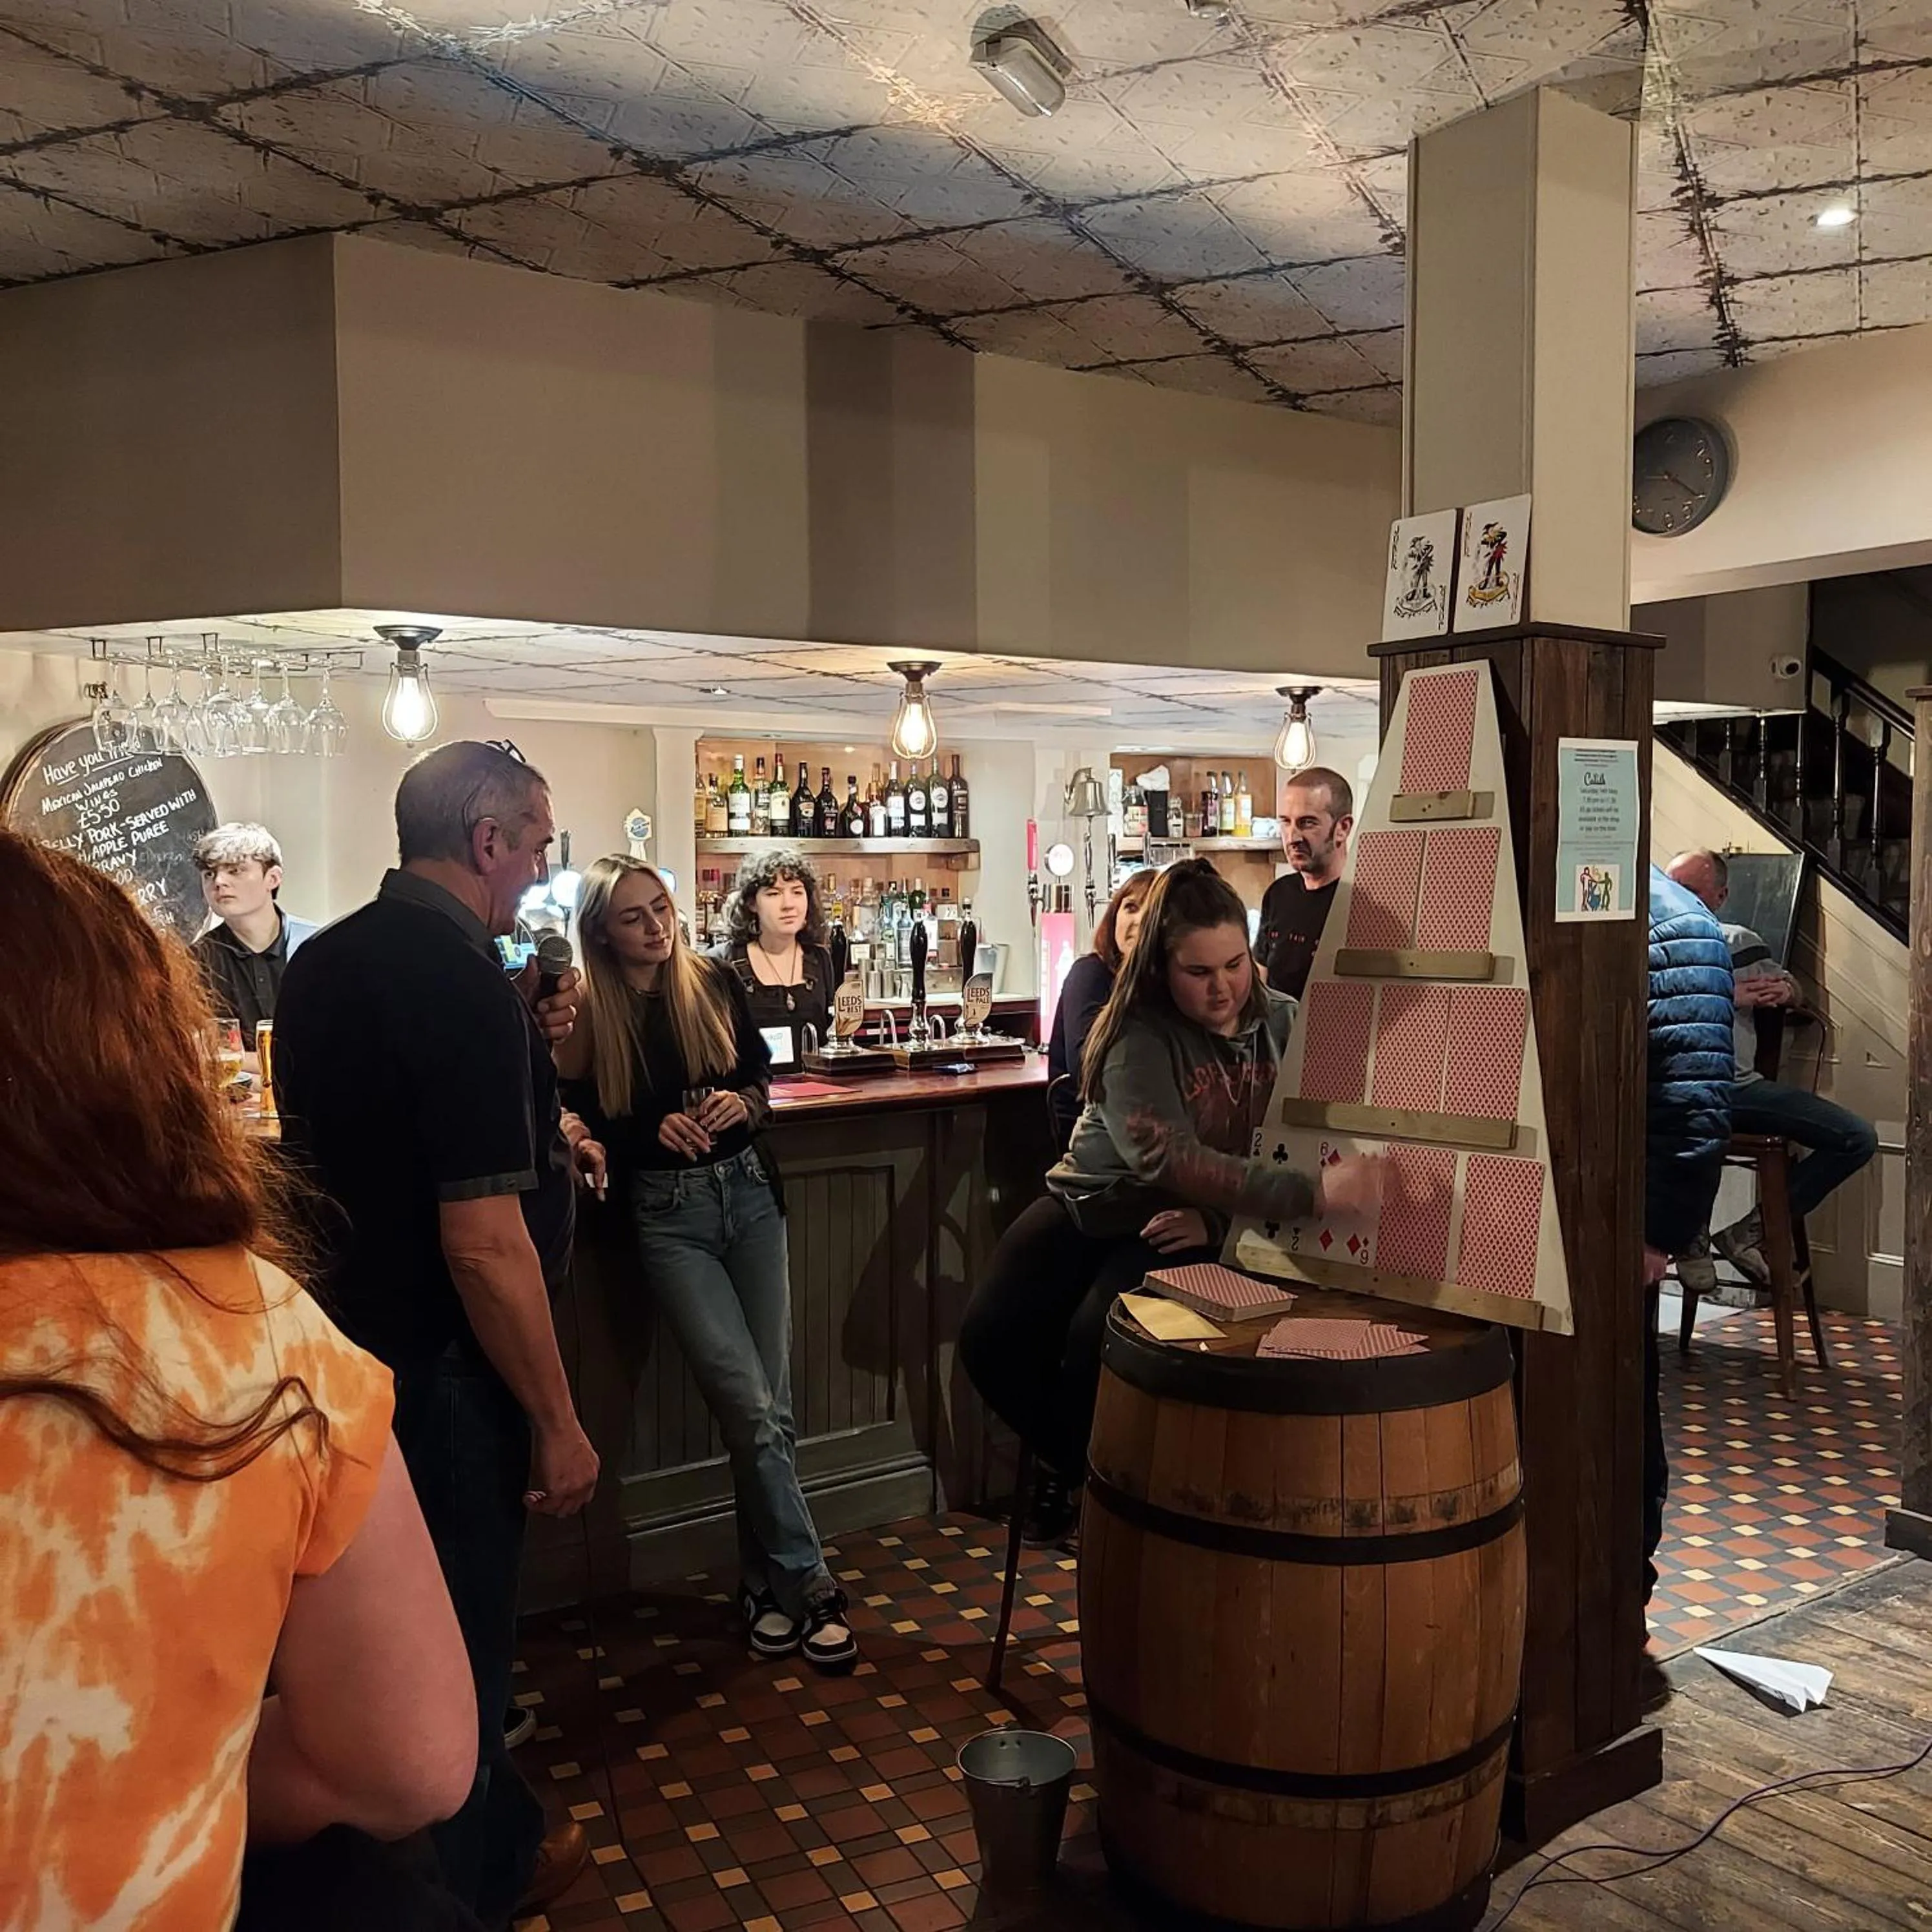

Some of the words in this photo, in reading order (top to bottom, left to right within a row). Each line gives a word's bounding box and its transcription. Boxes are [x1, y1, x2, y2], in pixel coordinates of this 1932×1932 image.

[43, 761, 76, 786] Have
[78, 751, 105, 777] you
[75, 789, 118, 812] WINGS
[168, 788, 196, 811] WITH
[92, 836, 128, 860] APPLE
[131, 820, 169, 846] PUREE
[838, 995, 862, 1012] LEEDS
[967, 987, 990, 1002] LEEDS
[1255, 1133, 1262, 1147] 2
